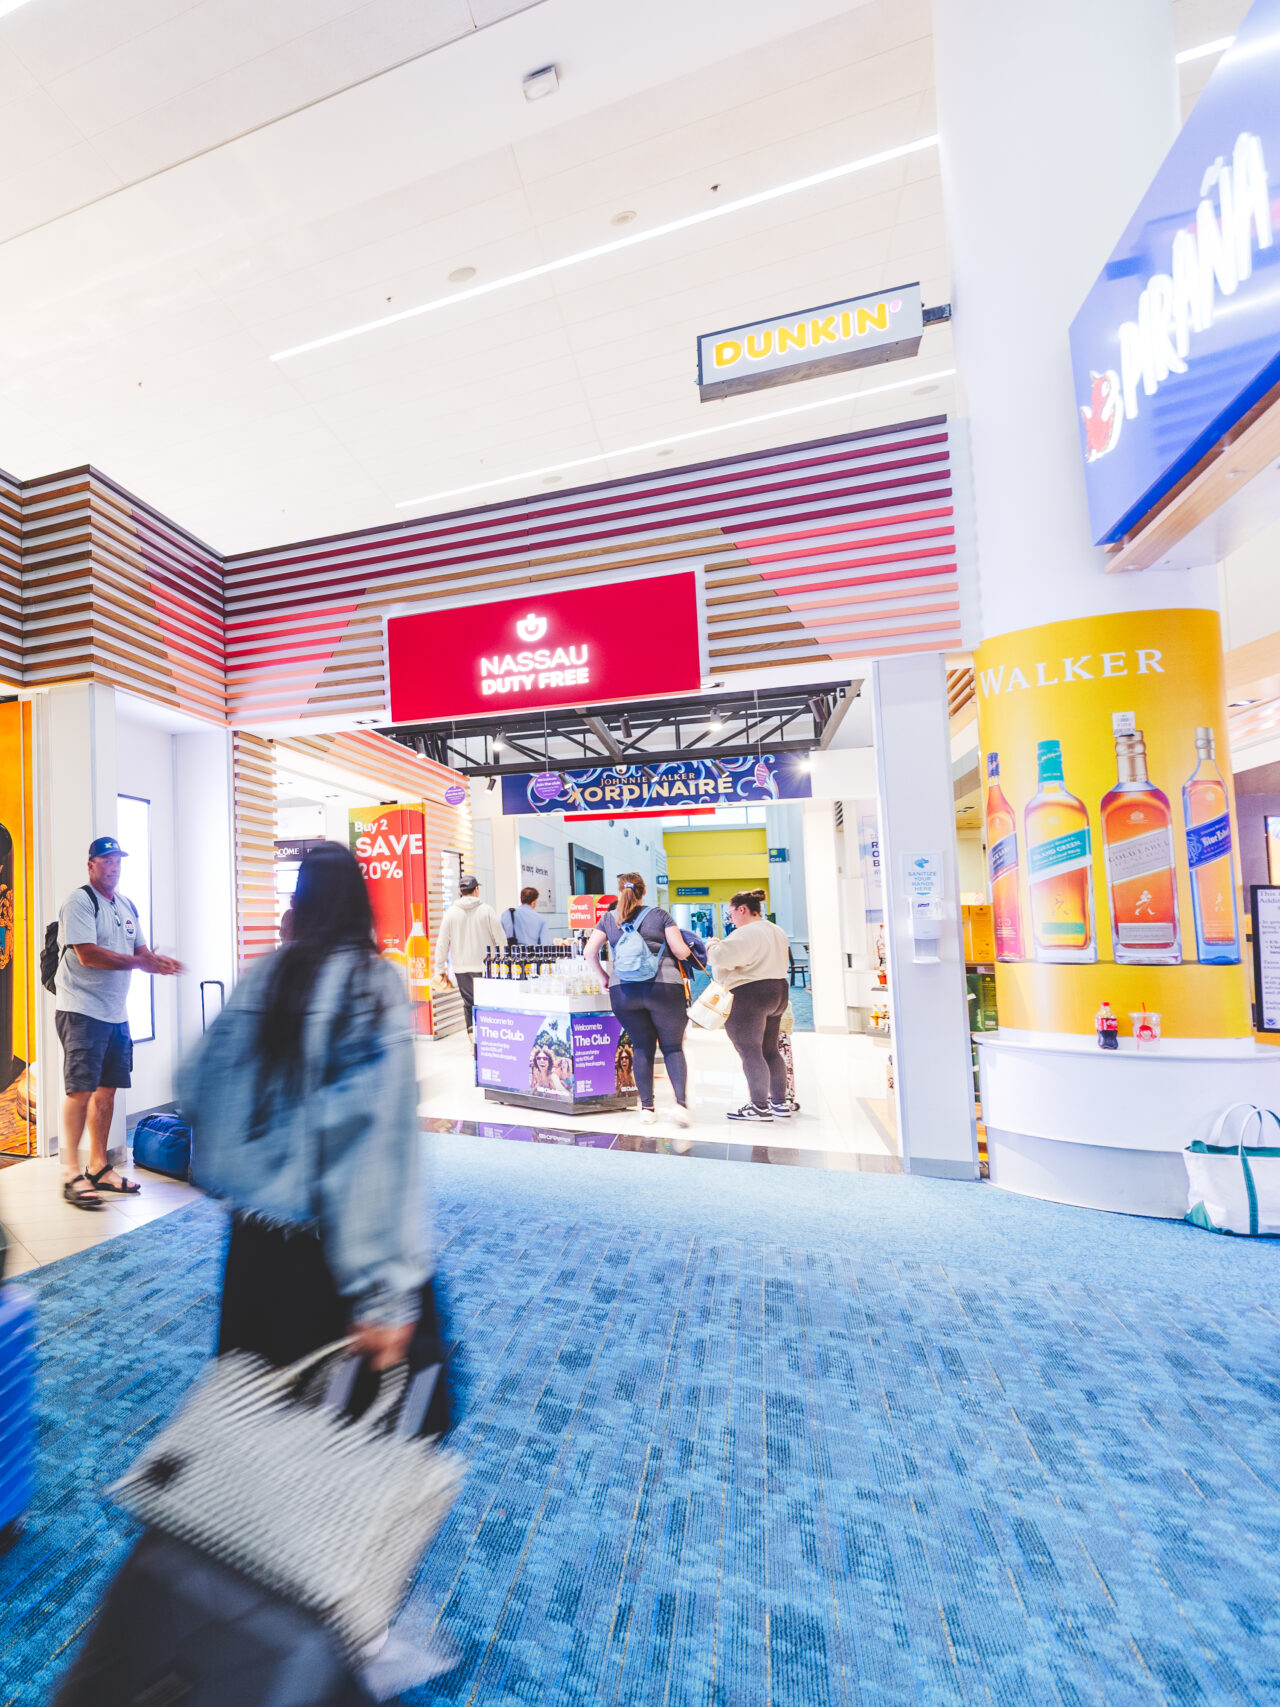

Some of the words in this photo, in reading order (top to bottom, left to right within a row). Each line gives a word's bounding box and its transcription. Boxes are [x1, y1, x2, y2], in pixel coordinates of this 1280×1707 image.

[481, 644, 588, 677] NASSAU
[979, 648, 1165, 699] WALKER
[482, 674, 532, 696] DUTY
[538, 667, 589, 689] FREE
[600, 776, 648, 788] JOHNNIE
[354, 820, 378, 834] Buy
[380, 819, 388, 831] 2
[355, 833, 424, 858] SAVE
[1108, 849, 1136, 863] GOLD
[359, 861, 403, 880] 20%
[570, 912, 591, 920] Offers
[479, 1015, 506, 1025] Welcome
[506, 1018, 514, 1026] to
[480, 1026, 499, 1039] The
[500, 1028, 525, 1042] Club
[574, 1035, 590, 1046] The
[591, 1033, 611, 1045] Club
